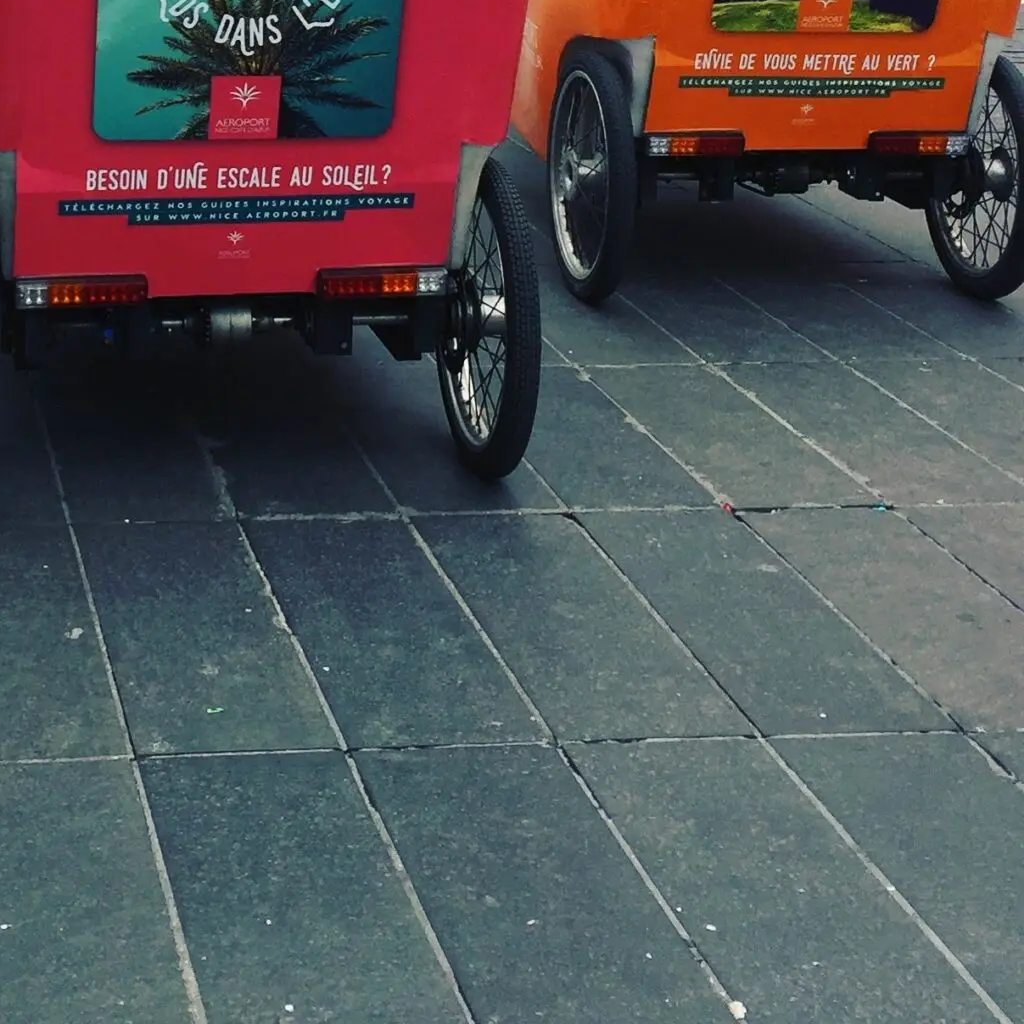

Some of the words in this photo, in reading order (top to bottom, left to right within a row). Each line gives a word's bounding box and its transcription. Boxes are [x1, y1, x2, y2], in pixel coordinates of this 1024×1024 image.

[214, 13, 283, 57] DANS
[694, 48, 734, 70] ENVIE
[738, 53, 757, 70] DE
[763, 53, 797, 71] VOUS
[802, 53, 857, 75] METTRE
[861, 54, 881, 71] AU
[887, 54, 921, 71] VERT
[825, 79, 897, 87] INSPIRATIONS
[215, 117, 271, 127] AEROPORT
[86, 168, 148, 191] BESOIN
[156, 161, 209, 190] D'UNE
[217, 166, 282, 189] ESCALE
[289, 166, 313, 187] AU
[64, 202, 160, 212] TÉLÉCHARGEZ
[167, 201, 193, 209] NOS
[201, 200, 249, 209] GUIDES
[256, 198, 350, 207] INSPIRATIONS
[358, 196, 409, 205] VOYAGE
[136, 213, 160, 222] SUR
